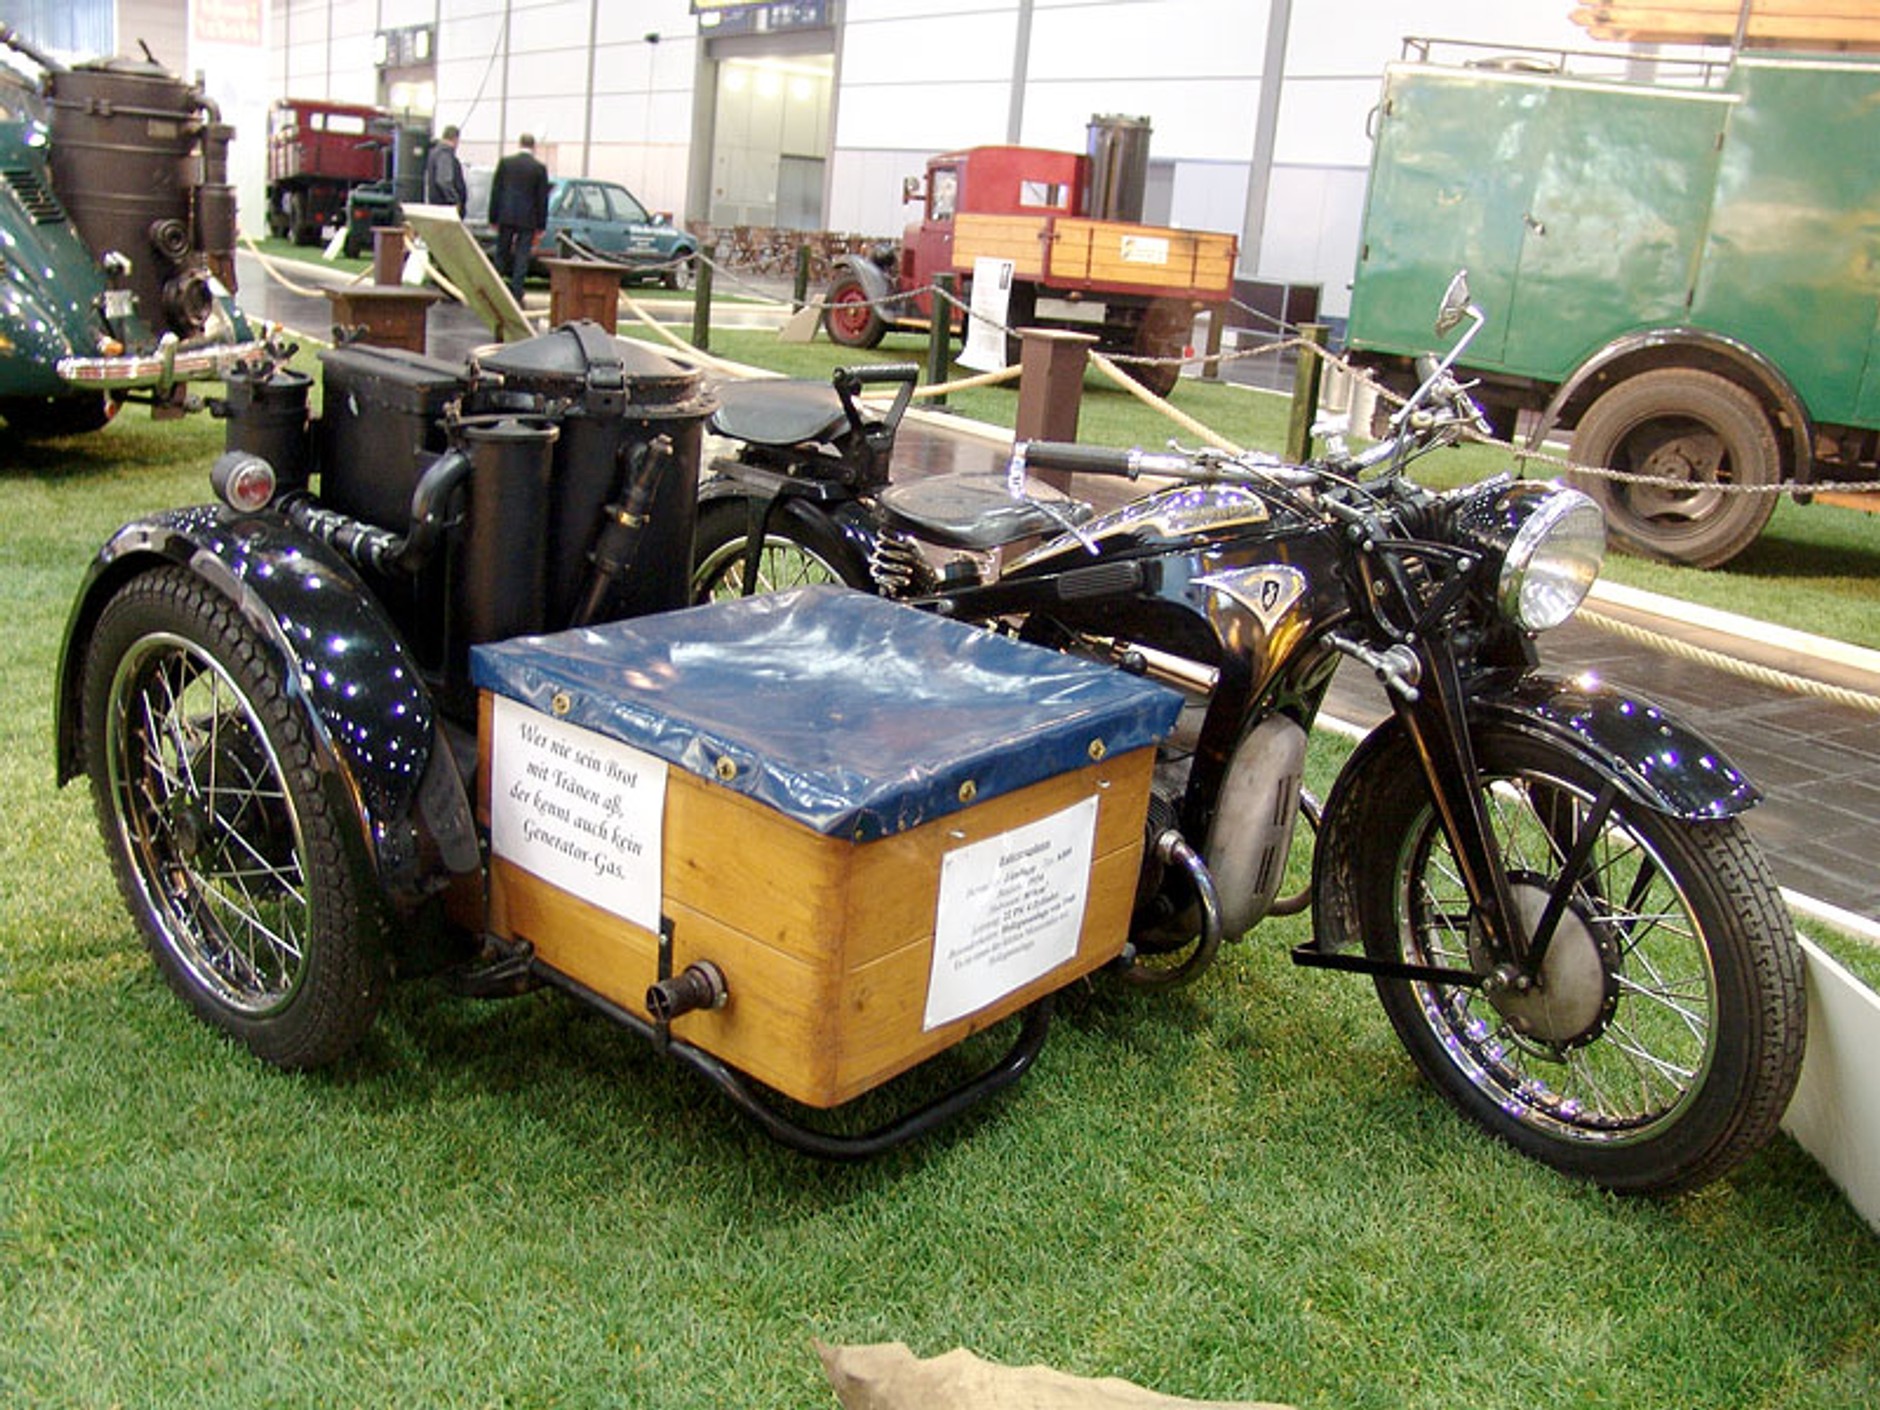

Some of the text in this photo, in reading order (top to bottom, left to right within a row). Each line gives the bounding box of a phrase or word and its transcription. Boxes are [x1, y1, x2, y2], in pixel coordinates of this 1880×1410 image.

[520, 722, 638, 788] Wer nie sein Brot
[527, 761, 548, 782] mit
[552, 769, 600, 805] Tränen
[510, 780, 643, 857] der kennt auch kein
[523, 819, 626, 880] Generator-Gas.
